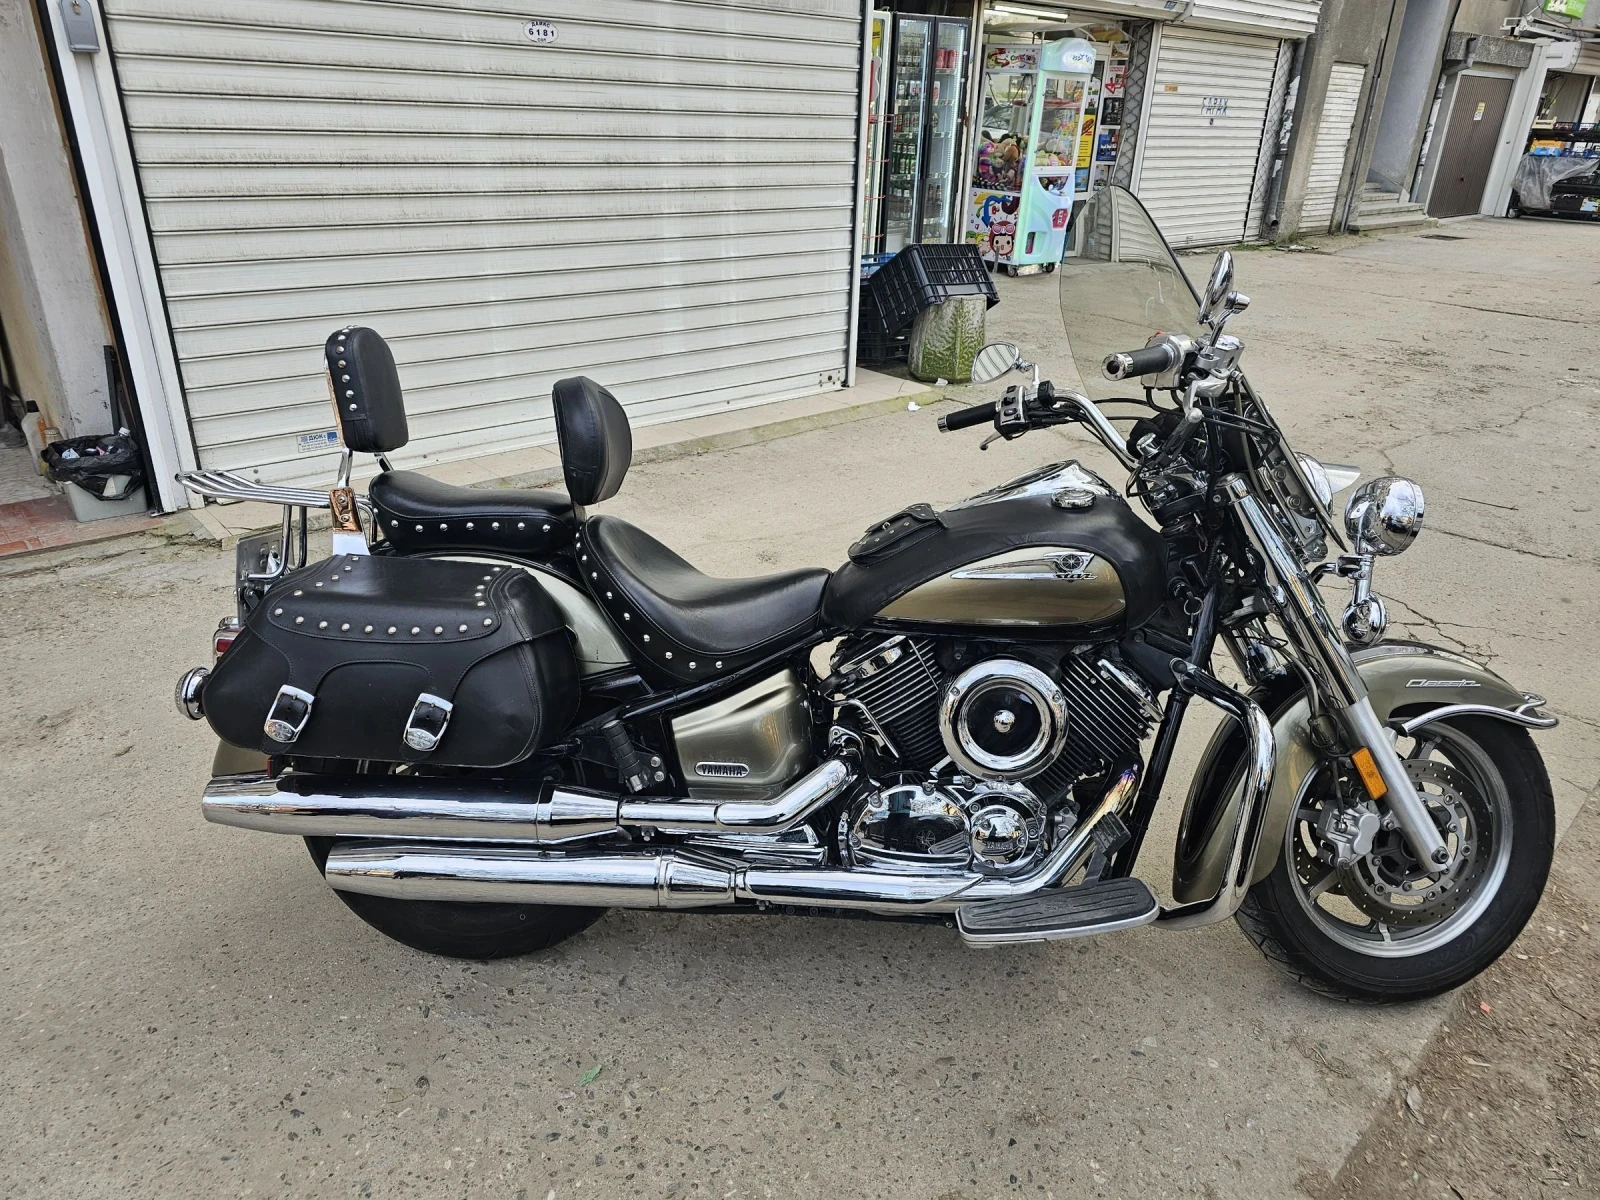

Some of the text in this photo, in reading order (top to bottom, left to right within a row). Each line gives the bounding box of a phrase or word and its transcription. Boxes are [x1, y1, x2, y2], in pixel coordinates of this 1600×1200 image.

[528, 28, 554, 37] 6181
[1405, 679, 1481, 687] Classic
[700, 764, 744, 776] YAMAHA
